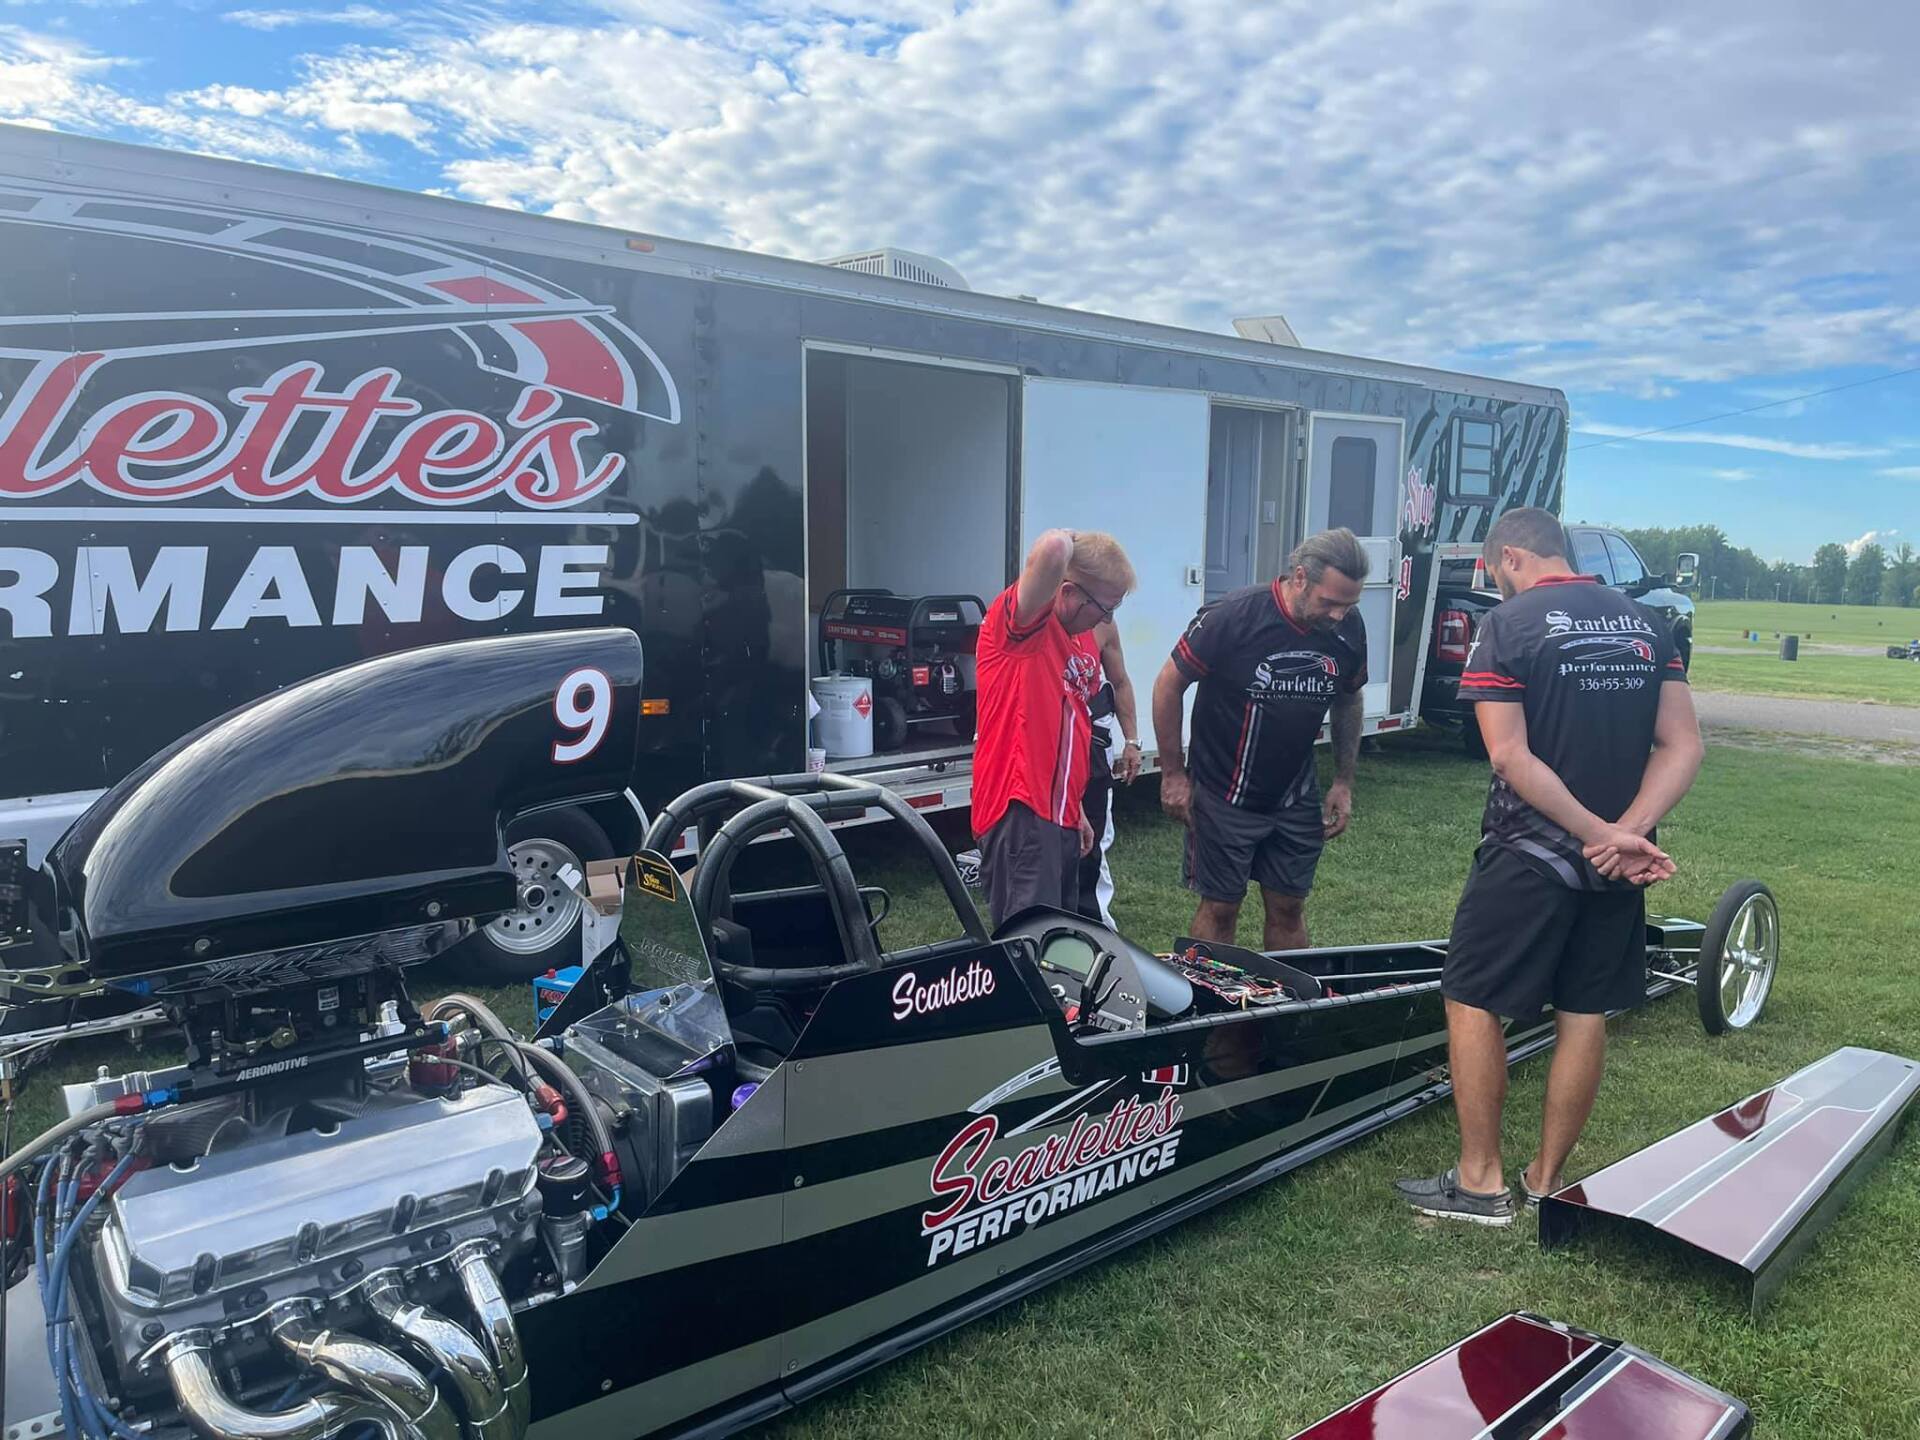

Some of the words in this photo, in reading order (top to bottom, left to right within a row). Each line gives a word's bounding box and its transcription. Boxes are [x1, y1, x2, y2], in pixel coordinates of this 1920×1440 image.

[1546, 609, 1653, 634] Scarlette's
[1250, 662, 1334, 692] Scarlette's
[1558, 661, 1657, 676] Performance
[551, 666, 614, 764] 9
[892, 961, 996, 1020] Scarlette
[236, 1056, 309, 1082] AEROMOTIVE
[922, 1085, 1184, 1230] Scarlette's
[927, 1138, 1181, 1267] PERFORMANCE
